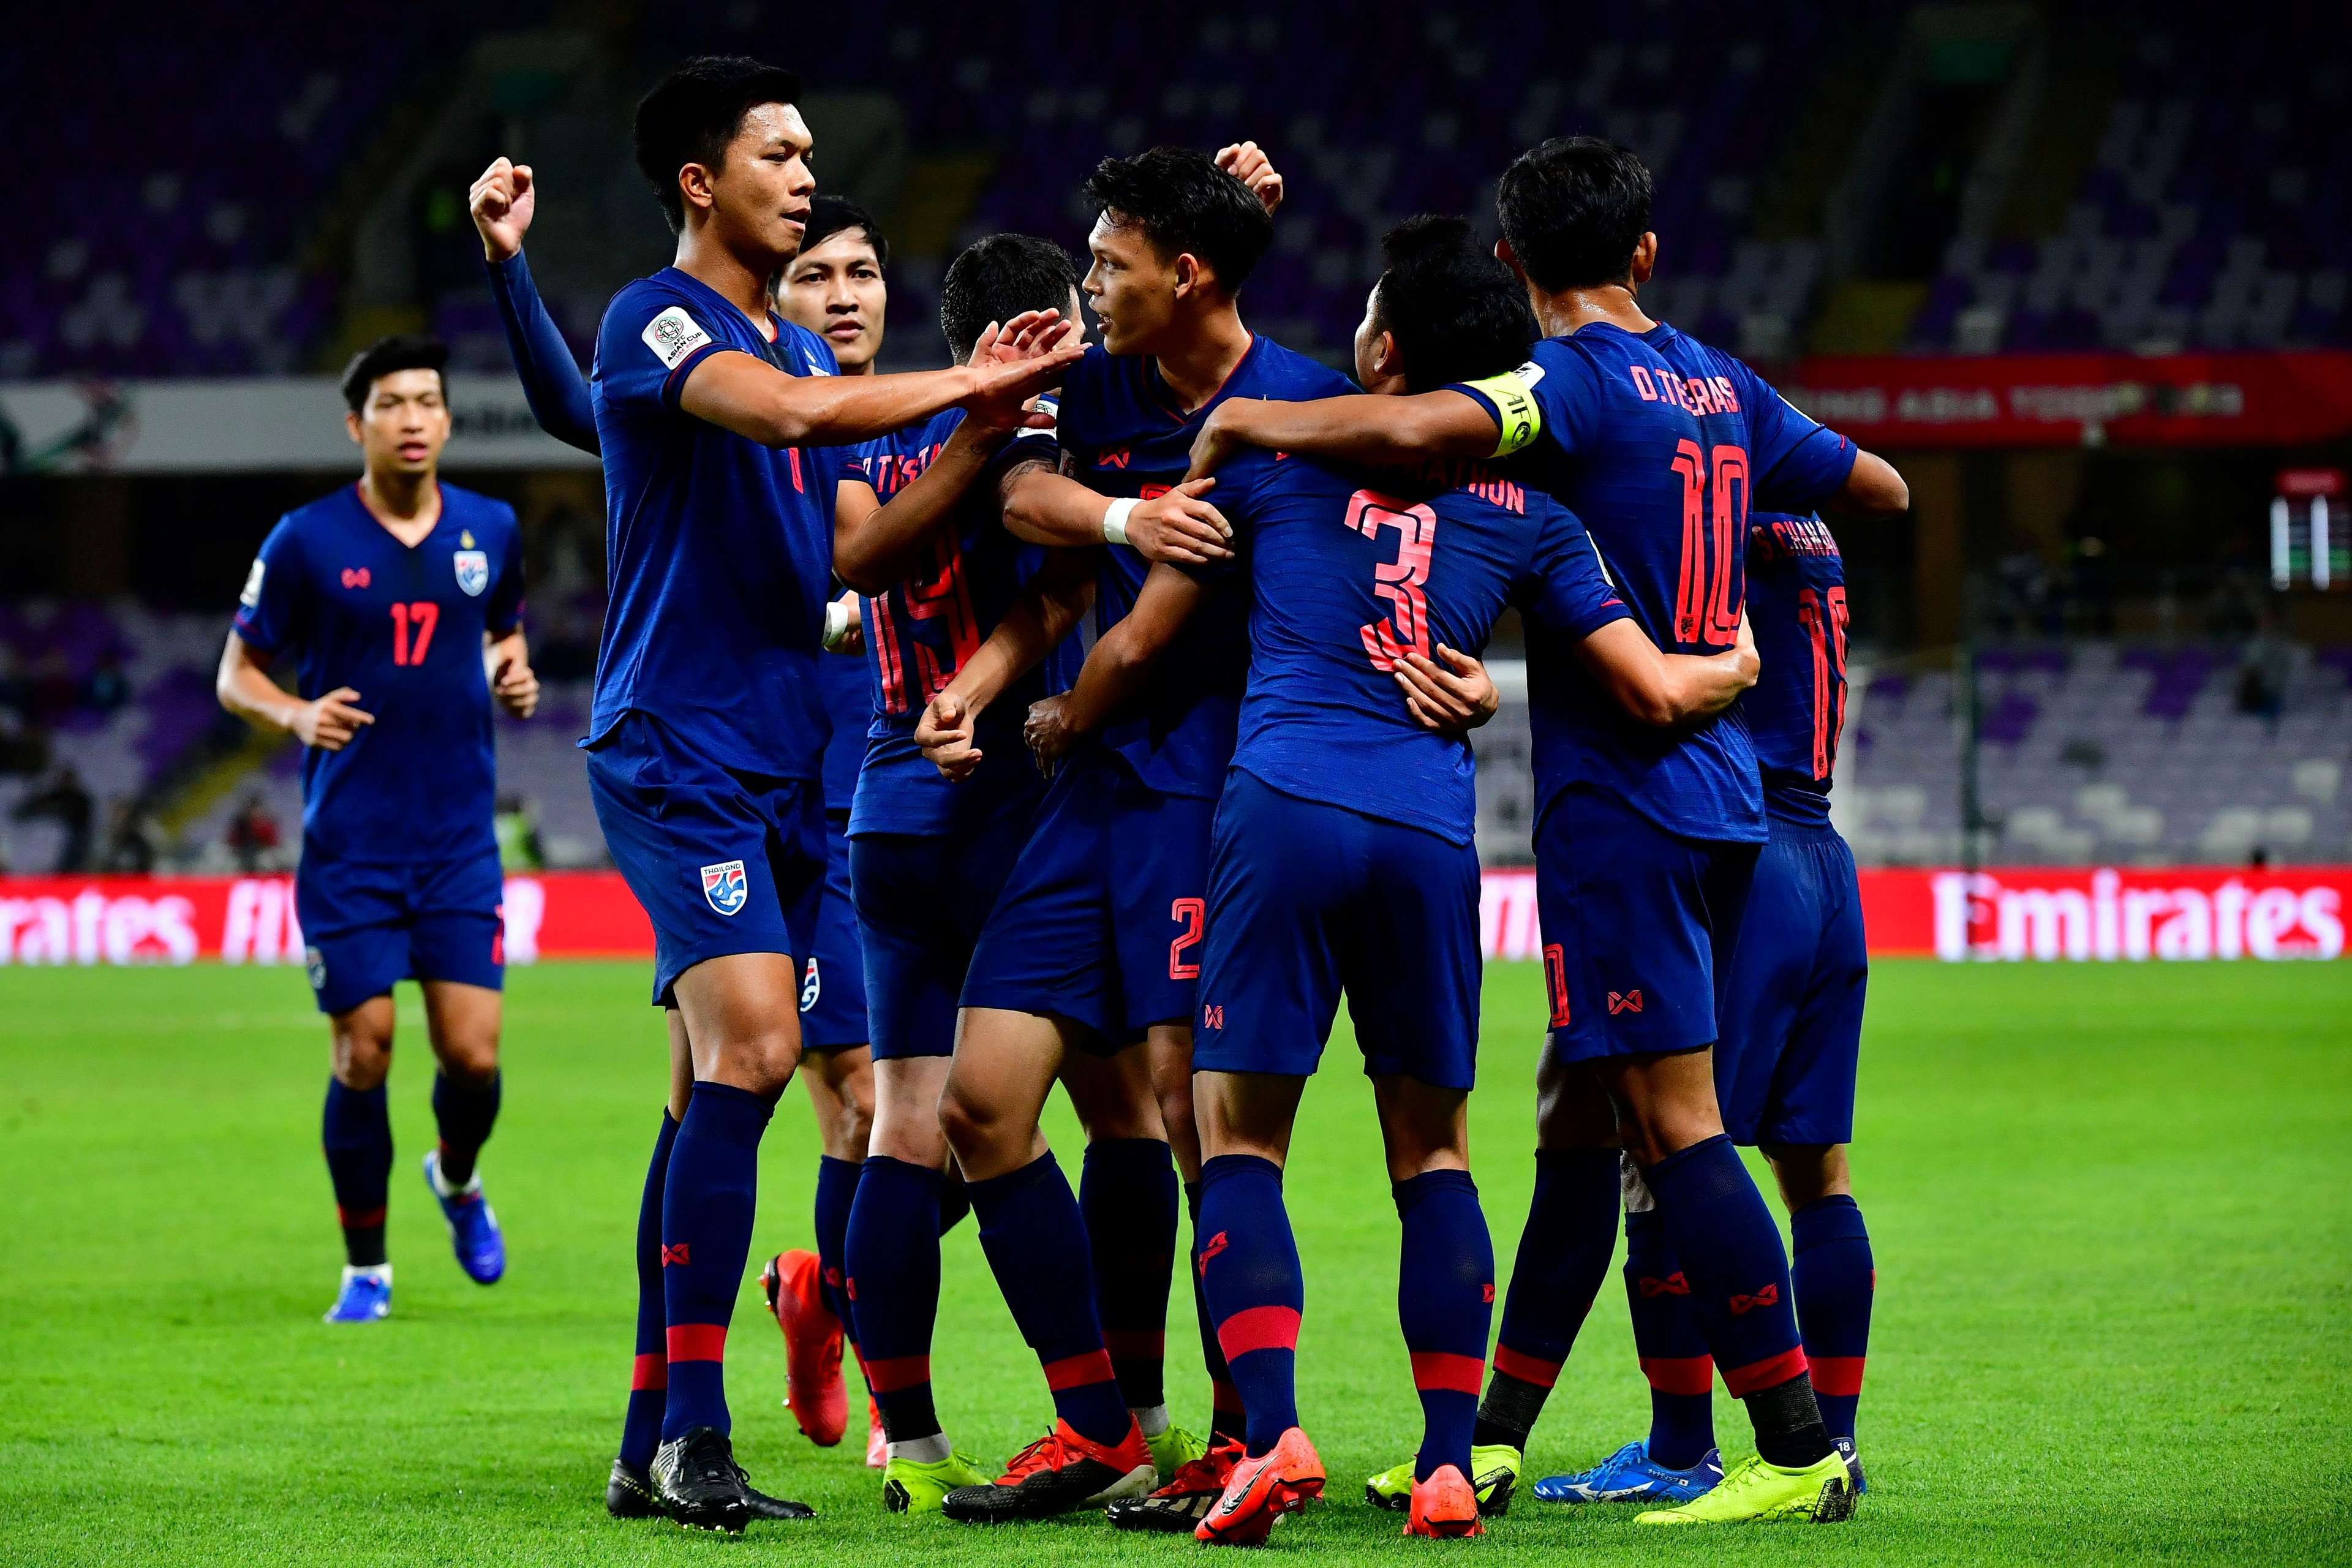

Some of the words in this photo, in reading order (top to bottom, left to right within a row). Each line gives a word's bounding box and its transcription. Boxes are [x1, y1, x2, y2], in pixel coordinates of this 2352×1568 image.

[668, 341, 687, 362] ASIAN
[687, 332, 703, 342] CUP
[674, 334, 686, 346] AFC
[676, 349, 685, 358] UAE
[1671, 439, 1748, 645] 10
[1344, 489, 1437, 674] 3
[390, 601, 439, 666] 17
[704, 863, 741, 875] THAILAND
[1932, 868, 2345, 962] Emirates
[1169, 898, 1205, 980] 2
[1838, 1442, 1850, 1452] 18
